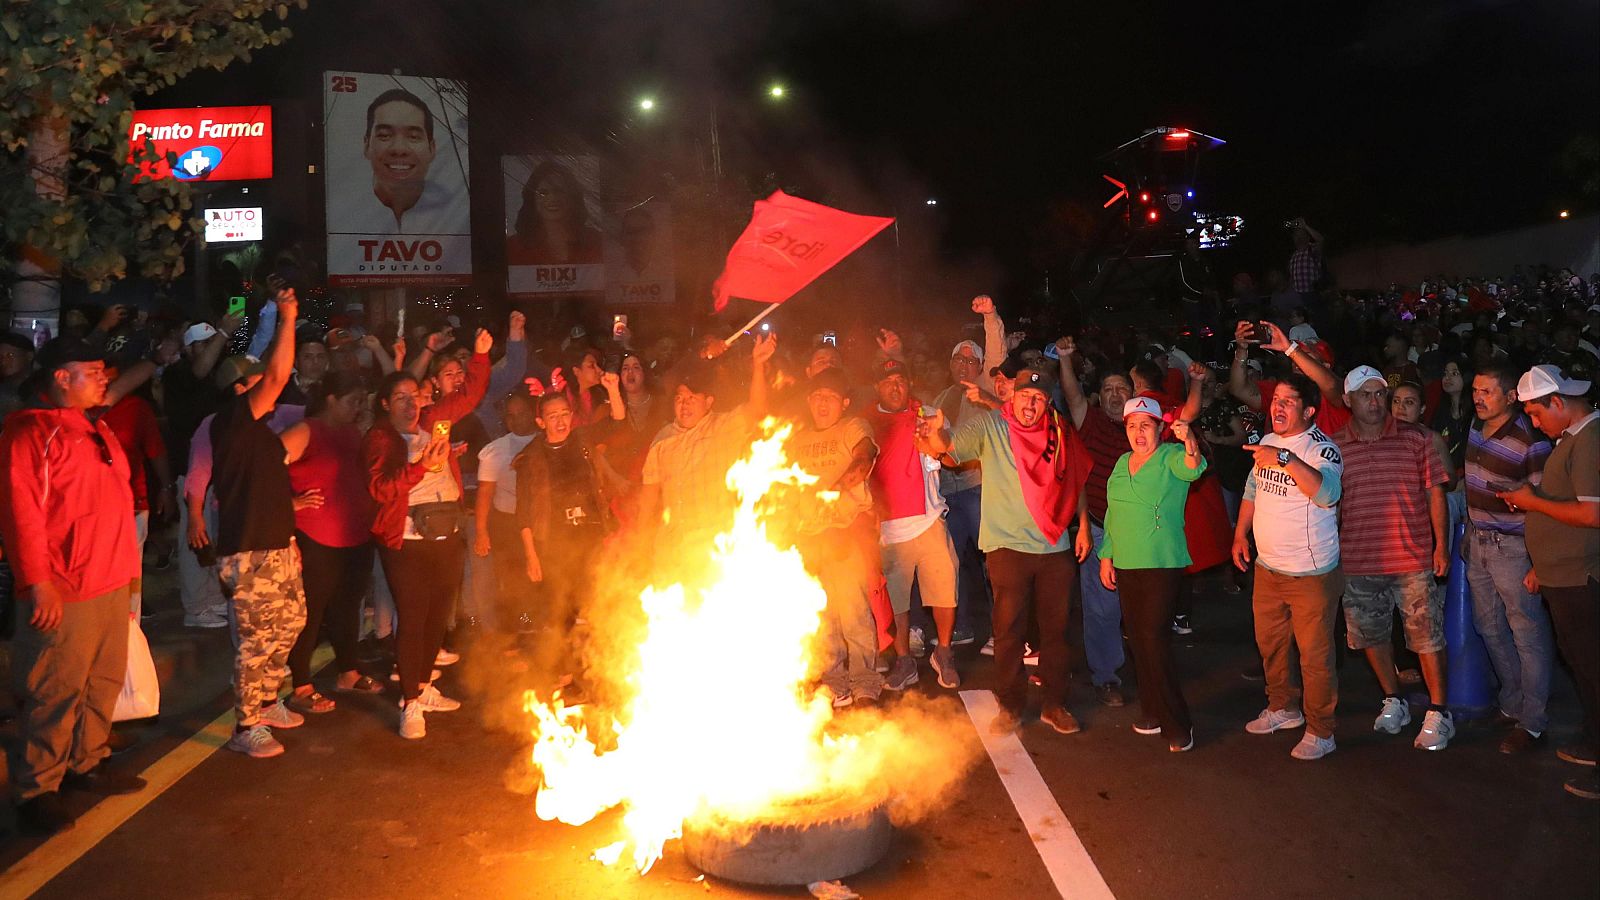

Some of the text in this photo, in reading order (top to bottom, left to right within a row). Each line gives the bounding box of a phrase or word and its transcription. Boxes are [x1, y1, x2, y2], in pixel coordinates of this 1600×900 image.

[331, 75, 358, 93] 25
[132, 119, 265, 141] Punto Farma
[212, 210, 255, 221] AUTO
[358, 240, 443, 262] TAVO
[359, 264, 442, 272] DIPUTADO
[536, 267, 577, 282] RIXI
[619, 284, 661, 297] TAVO
[1255, 466, 1298, 486] mirates
[1263, 481, 1288, 497] BETTER
